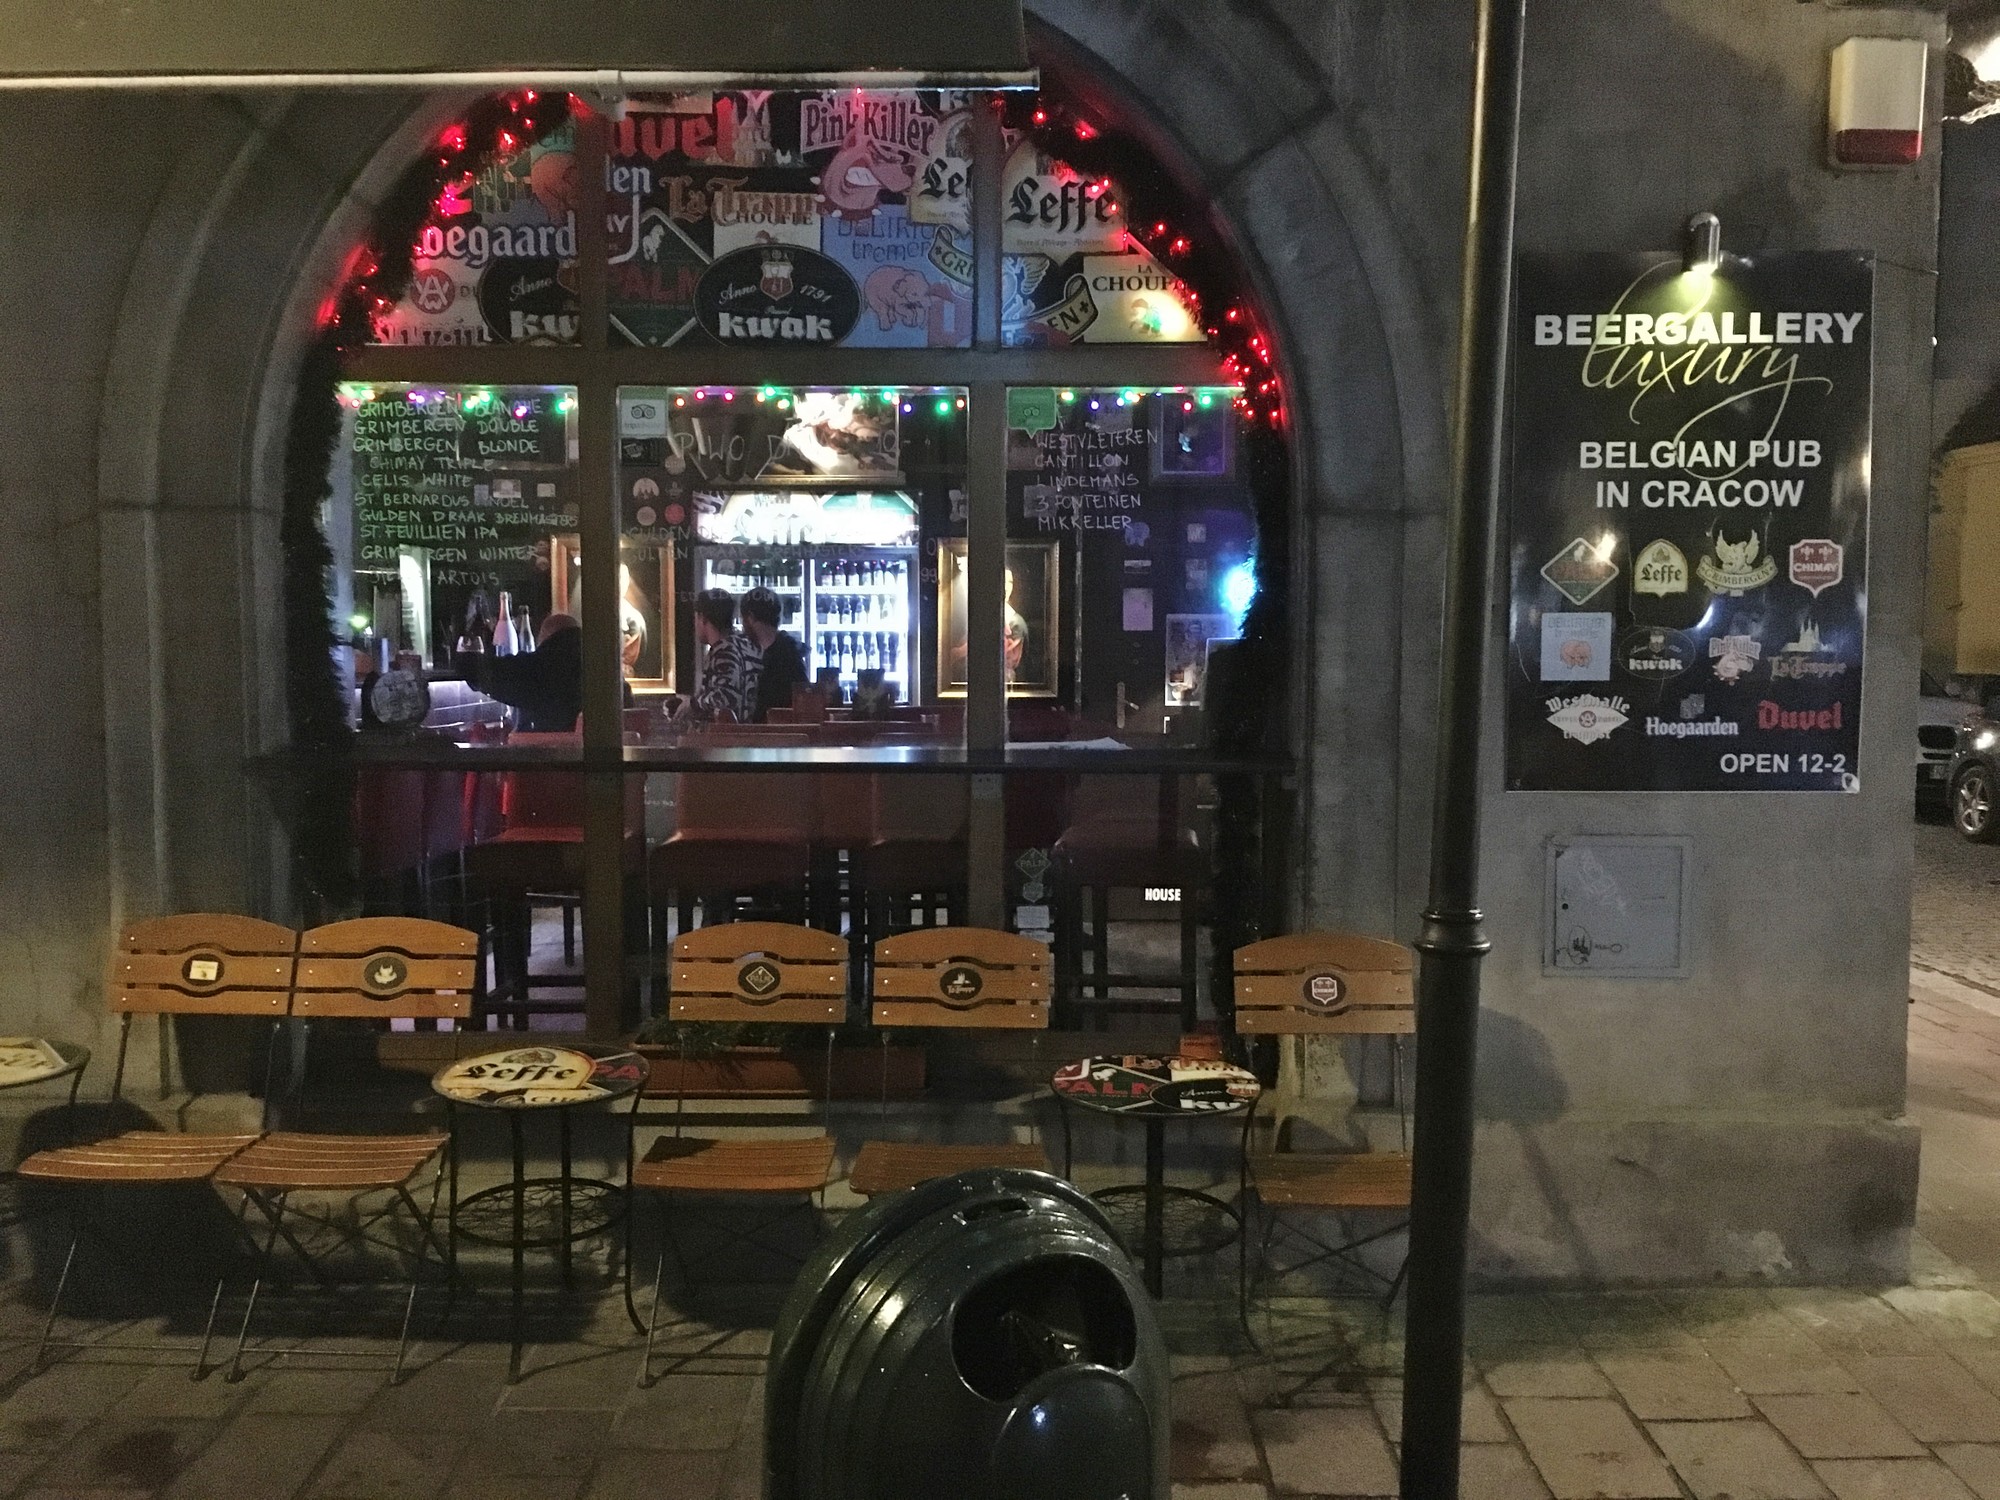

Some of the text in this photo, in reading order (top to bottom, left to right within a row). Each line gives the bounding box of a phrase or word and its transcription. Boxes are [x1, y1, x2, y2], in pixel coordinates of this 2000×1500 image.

[863, 101, 934, 156] Killer
[1004, 175, 1116, 233] Leffe
[422, 210, 577, 265] oegaard
[1535, 312, 1864, 345] BEERGALLERY
[354, 418, 466, 435] GRIMBERGEN
[353, 438, 540, 455] GRIMBERGEN BLONDE
[1579, 440, 1822, 468] BELGIAN PUB
[361, 474, 410, 488] CELIS
[1597, 479, 1805, 508] IN CRACOW
[358, 509, 422, 524] GULDEN
[432, 510, 487, 523] DRAAK
[1038, 515, 1134, 532] MIKKELLER
[474, 526, 499, 540] IPA
[1640, 563, 1683, 582] Leffe
[1703, 566, 1772, 587] GRIMBERGEN
[1793, 562, 1839, 573] CHIMAY
[1758, 700, 1843, 730] Duvel
[1645, 716, 1739, 739] Hoegaarden
[1720, 753, 1847, 774] OPEN 12-2
[1145, 887, 1182, 902] HOUSE
[453, 1063, 579, 1082] Leffe
